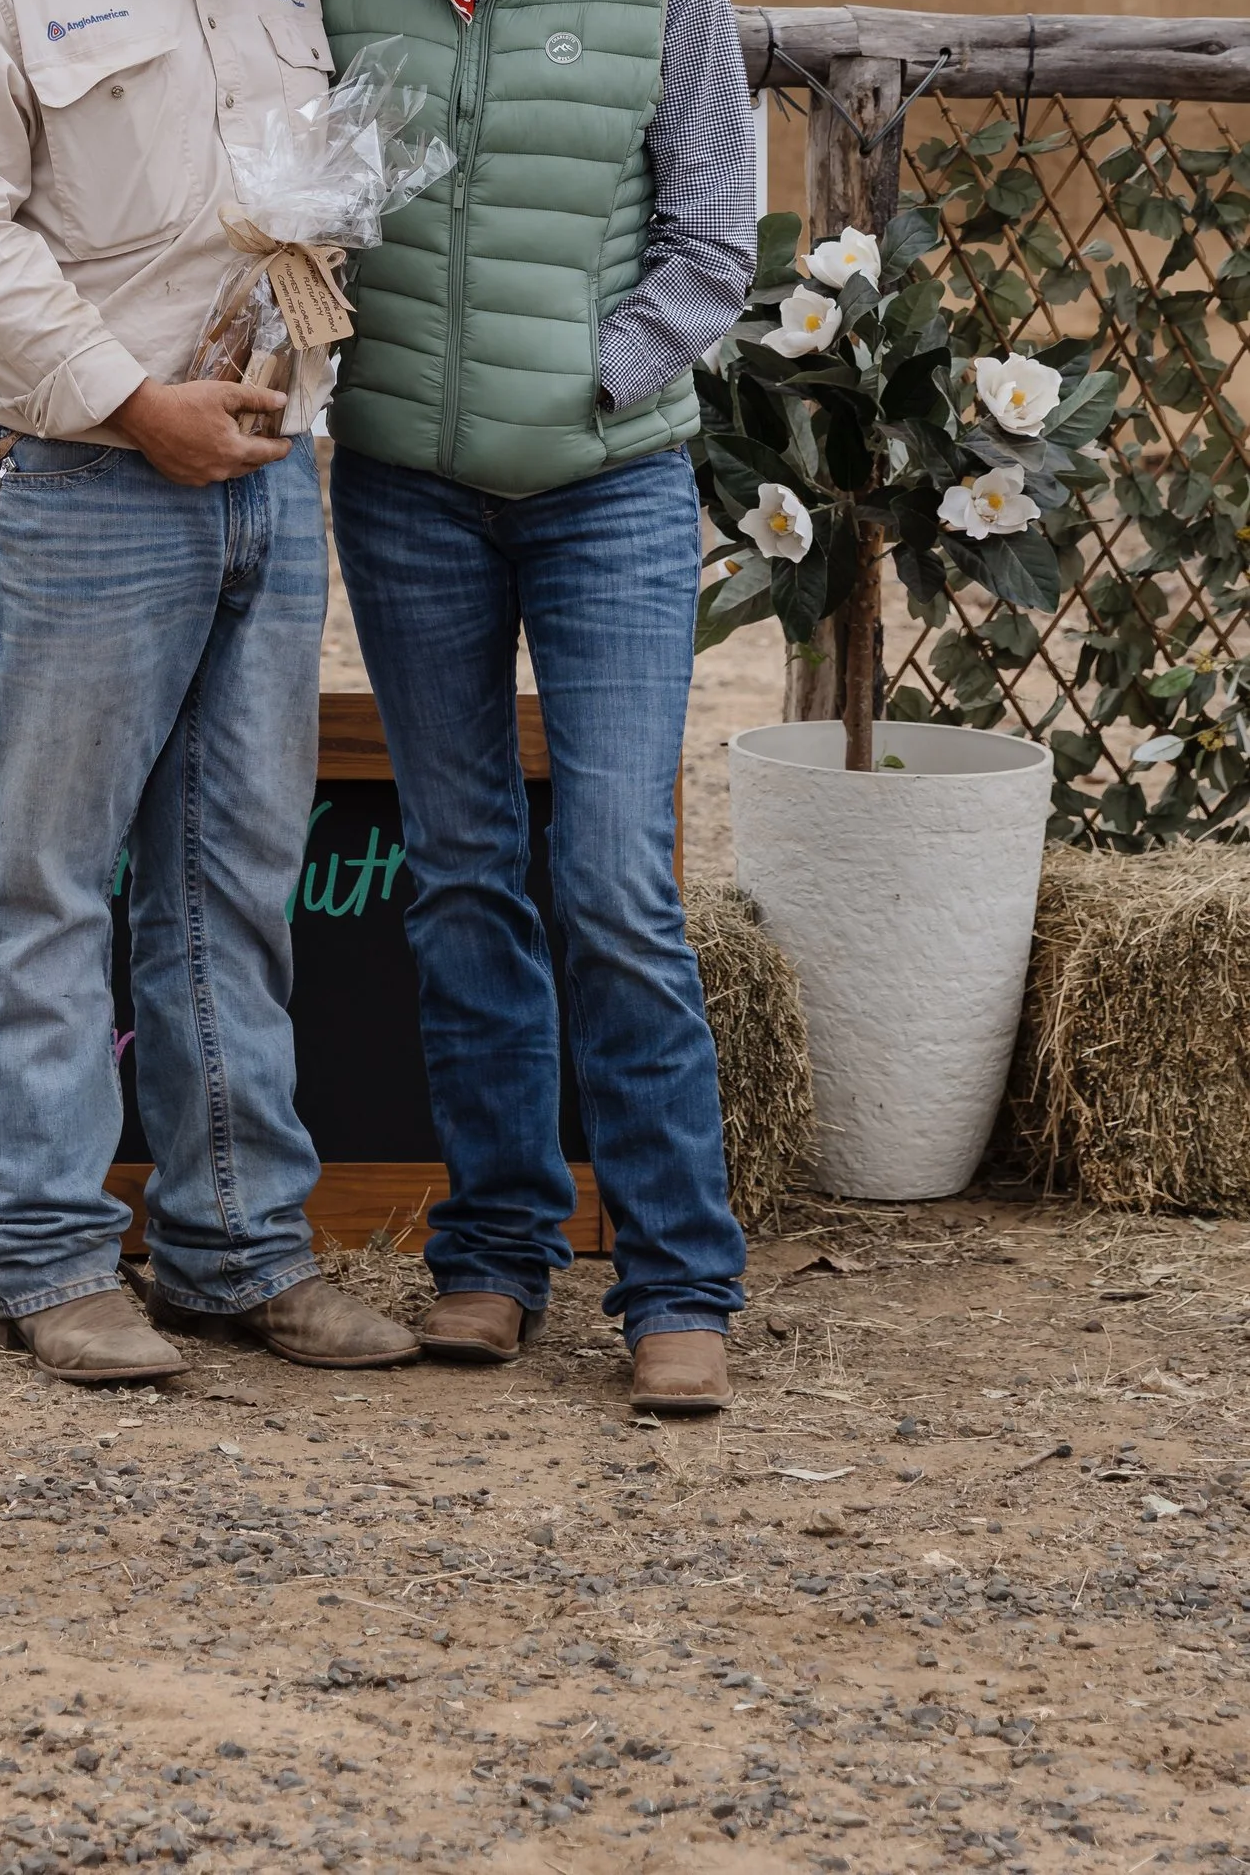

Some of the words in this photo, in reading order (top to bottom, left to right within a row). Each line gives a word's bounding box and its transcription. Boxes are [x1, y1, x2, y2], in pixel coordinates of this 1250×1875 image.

[66, 8, 130, 31] AngloAmerican
[277, 274, 297, 315] COMMITTEE
[284, 262, 301, 295] HIGHEST
[297, 299, 315, 335] SCORING
[303, 276, 325, 316] FUTURITY
